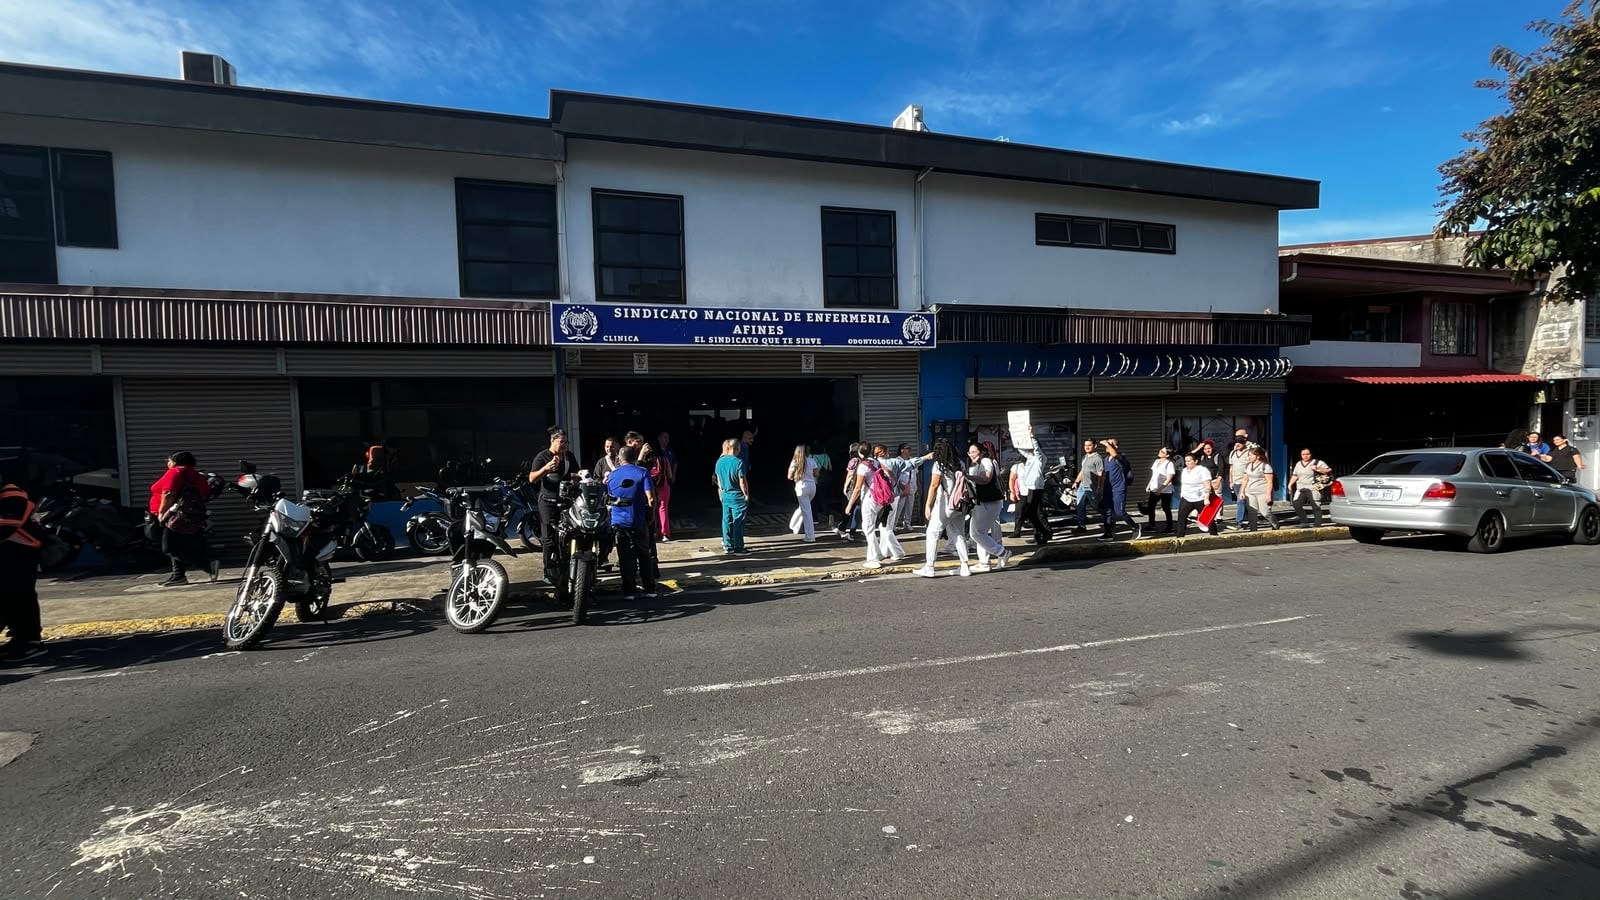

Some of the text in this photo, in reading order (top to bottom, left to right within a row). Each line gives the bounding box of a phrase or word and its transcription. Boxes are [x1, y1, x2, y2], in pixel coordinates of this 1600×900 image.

[614, 308, 891, 324] SINDICATO NACIONAL DE ENFERMERIA
[733, 324, 784, 335] AFINES
[603, 335, 640, 343] CLINICA
[708, 336, 759, 344] SINDICATO
[761, 337, 780, 346] QUE
